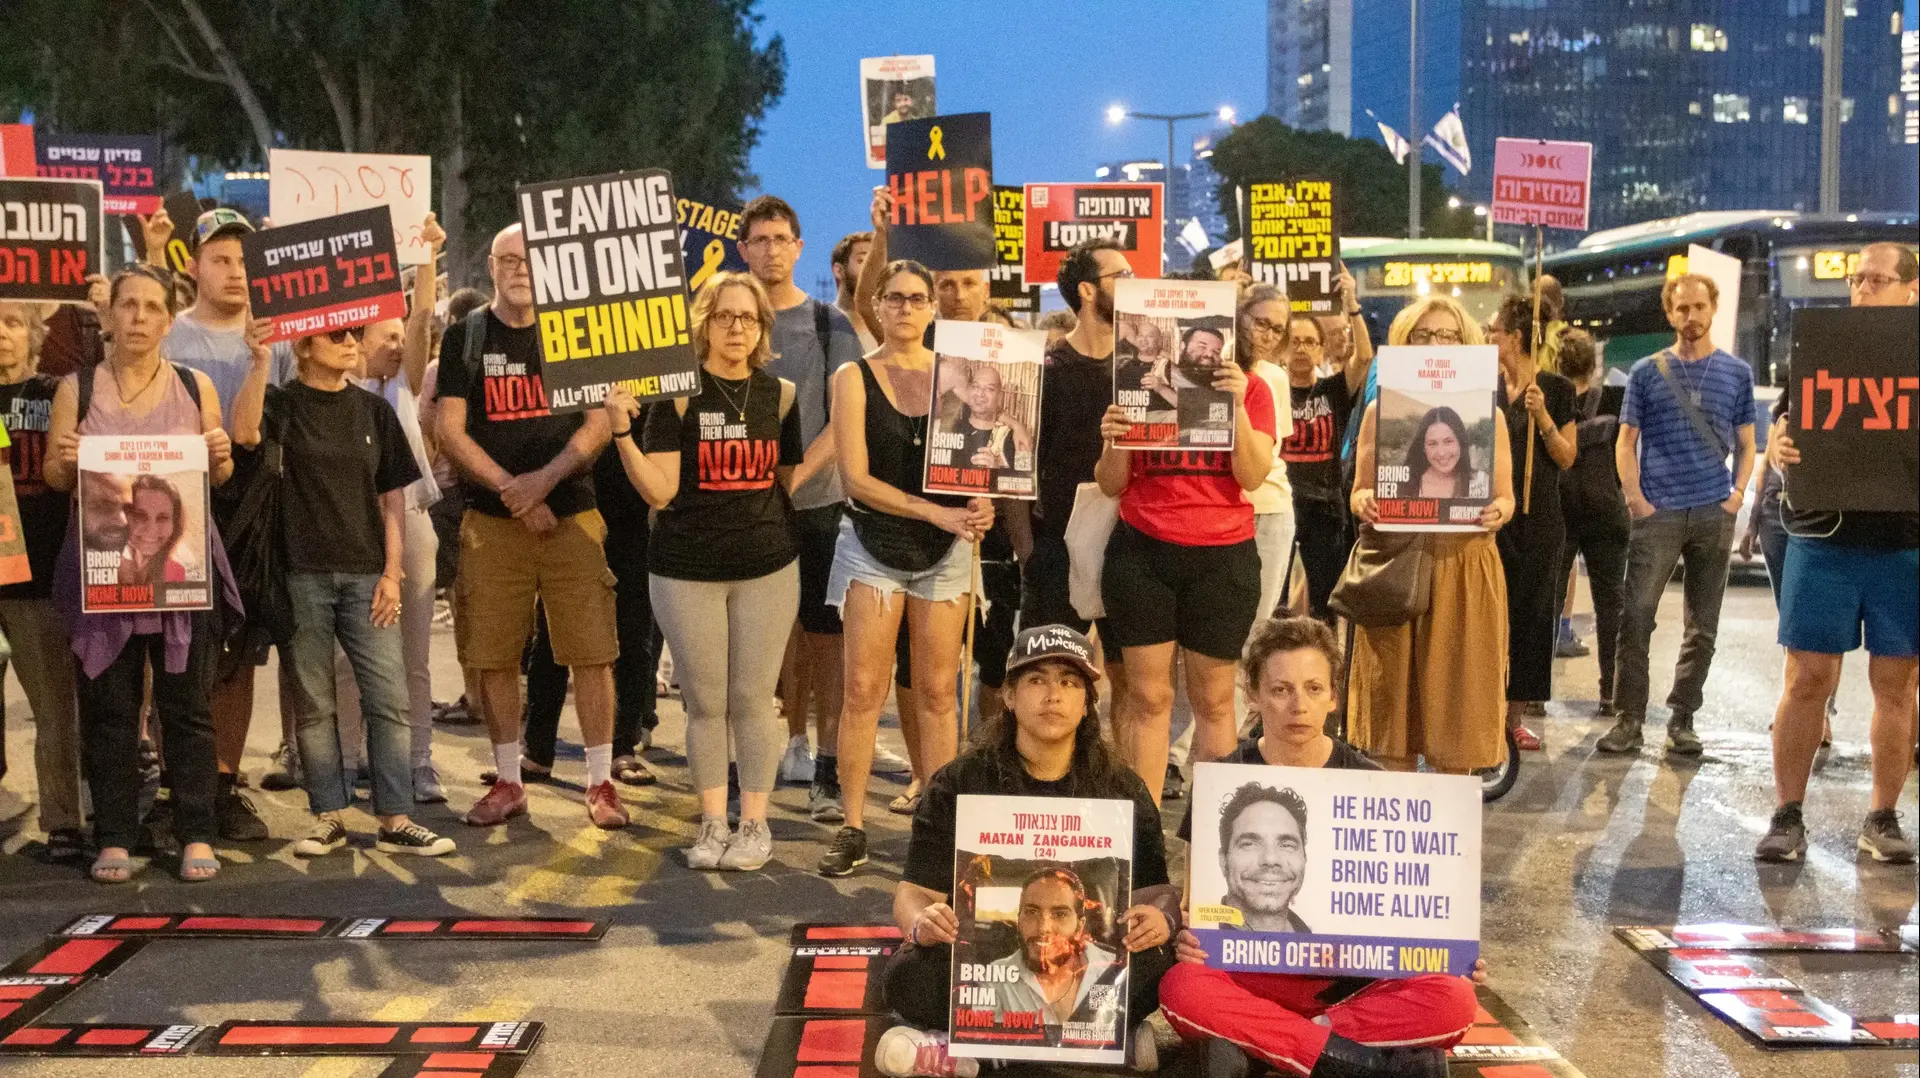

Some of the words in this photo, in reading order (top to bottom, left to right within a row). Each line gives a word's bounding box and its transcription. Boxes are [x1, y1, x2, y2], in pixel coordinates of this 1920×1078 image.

[889, 167, 990, 226] HELP
[1296, 180, 1332, 201] אילו
[1500, 179, 1581, 204] מחזירות
[521, 175, 673, 241] LEAVING
[1078, 197, 1125, 216] תרופה
[1128, 196, 1150, 217] אין
[1311, 201, 1332, 218] חיי
[1494, 206, 1541, 224] הביתה
[0, 201, 87, 242] השב
[1287, 217, 1332, 234] והשיב
[1544, 210, 1584, 226] אותם
[328, 229, 374, 256] פדיון
[1252, 232, 1332, 259] לביתם?
[264, 239, 324, 267] שבויים
[51, 248, 87, 285] או
[336, 251, 396, 288] בכל
[530, 242, 590, 305] NO
[594, 230, 681, 296] ONE
[252, 266, 330, 304] מחיר
[1158, 299, 1170, 309] AND
[329, 304, 380, 327] #עסקה
[280, 317, 325, 336] עכשיו!
[539, 294, 690, 363] BEHIND!
[483, 353, 507, 365] BRING
[485, 365, 505, 377] THEM
[506, 363, 527, 376] HOME
[1418, 369, 1441, 379] NAAMA
[1441, 369, 1457, 379] LEVY
[553, 388, 578, 408] ALL
[660, 371, 696, 394] NOW!
[1118, 390, 1150, 406] BRING
[699, 412, 726, 426] BRING
[700, 425, 722, 440] THEM
[723, 424, 748, 439] HOME
[932, 432, 964, 450] BRING
[123, 451, 137, 461] AND
[698, 440, 778, 482] NOW!
[930, 448, 953, 465] HIM
[929, 466, 959, 484] HOME
[960, 467, 990, 487] NOW!
[1378, 466, 1410, 483] BRING
[1377, 482, 1398, 499] HER
[1408, 499, 1439, 517] NOW!
[86, 551, 121, 568] BRING
[87, 568, 119, 584] THEM
[87, 585, 119, 602] HOME
[121, 584, 153, 602] NOW!
[1333, 795, 1357, 820] HE
[1363, 797, 1401, 822] HAS
[1406, 799, 1432, 823] NO
[1060, 815, 1081, 831] מתן
[979, 833, 1024, 845] MATAN
[1033, 834, 1112, 848] ZANGAUKER
[1332, 827, 1378, 852] TIME
[1383, 829, 1406, 854] TO
[1411, 831, 1462, 856] WAIT.
[1034, 848, 1057, 858] (24)
[1332, 859, 1388, 885] BRING
[1394, 862, 1430, 886] HIM
[1331, 891, 1385, 917] HOME
[1390, 895, 1450, 920] ALIVE!
[1222, 939, 1280, 965] BRING
[1285, 941, 1334, 968] OFER
[1339, 943, 1394, 971] HOME
[1399, 946, 1450, 973] NOW!
[960, 963, 1020, 983] BRING
[959, 986, 996, 1006] HIM
[956, 1008, 994, 1027] HOME
